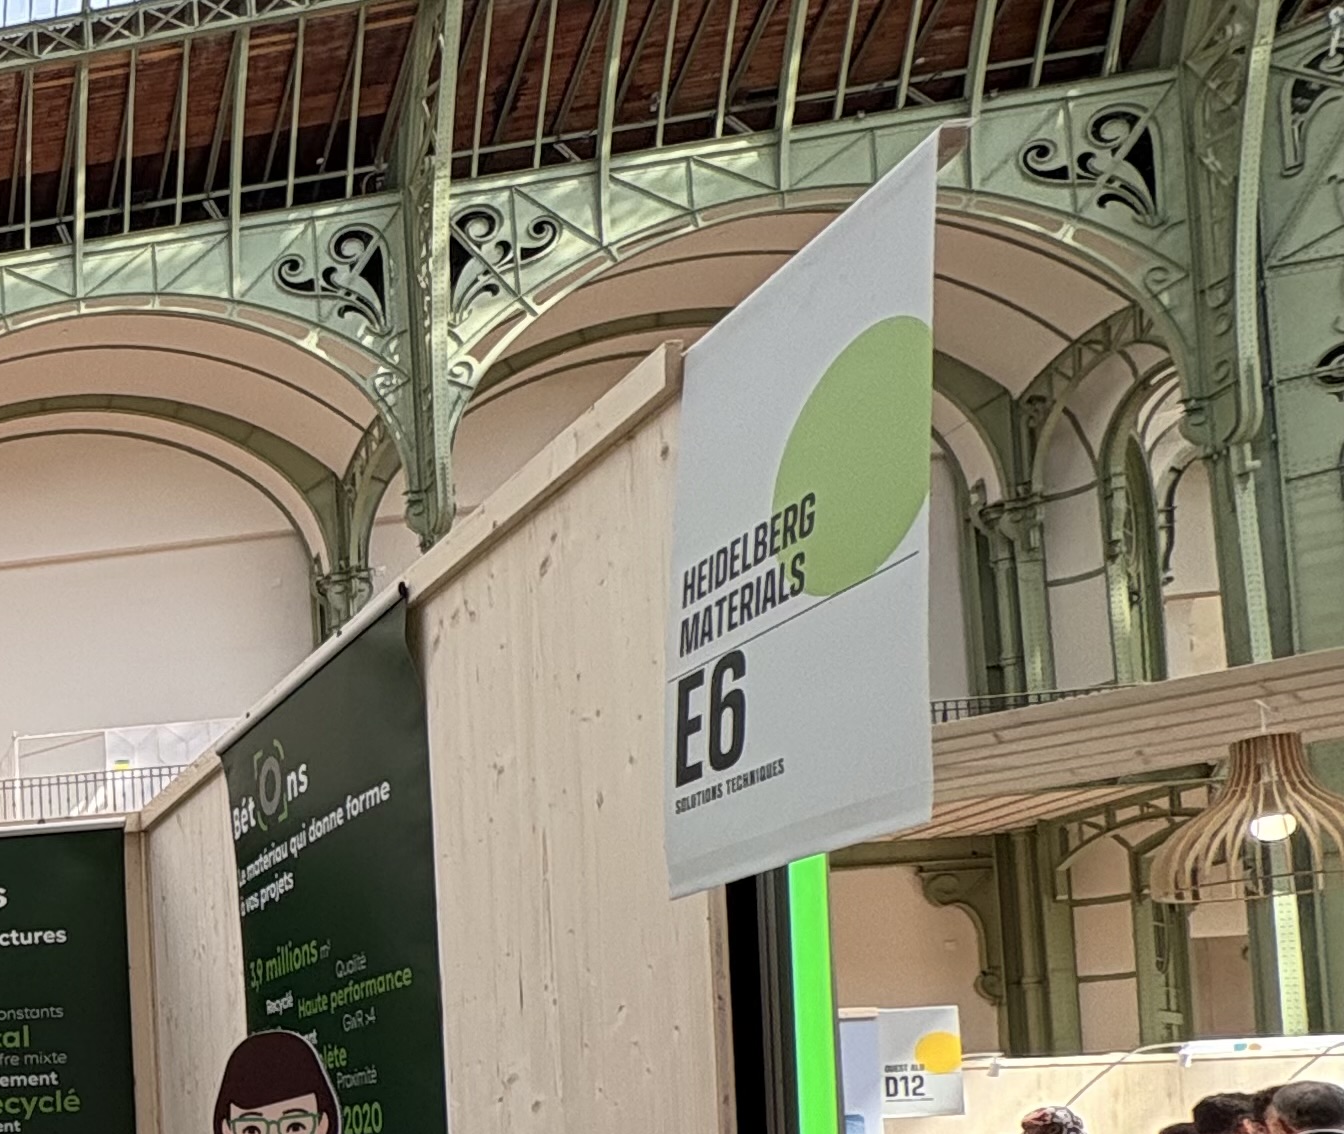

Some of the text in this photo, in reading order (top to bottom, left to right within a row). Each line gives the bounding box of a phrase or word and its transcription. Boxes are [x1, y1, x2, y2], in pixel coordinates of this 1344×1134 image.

[682, 492, 816, 609] HEIDELBERG
[679, 550, 806, 658] MATERIALS
[675, 649, 747, 788] E6
[675, 757, 785, 815] SOLUTIONS TECHNIQUES
[246, 780, 391, 883] matériau qui donne forme
[260, 871, 294, 911] projets
[265, 939, 318, 983] millions
[298, 966, 413, 1020] Haute performance
[23, 1050, 67, 1066] mixte
[885, 1074, 926, 1098] D12
